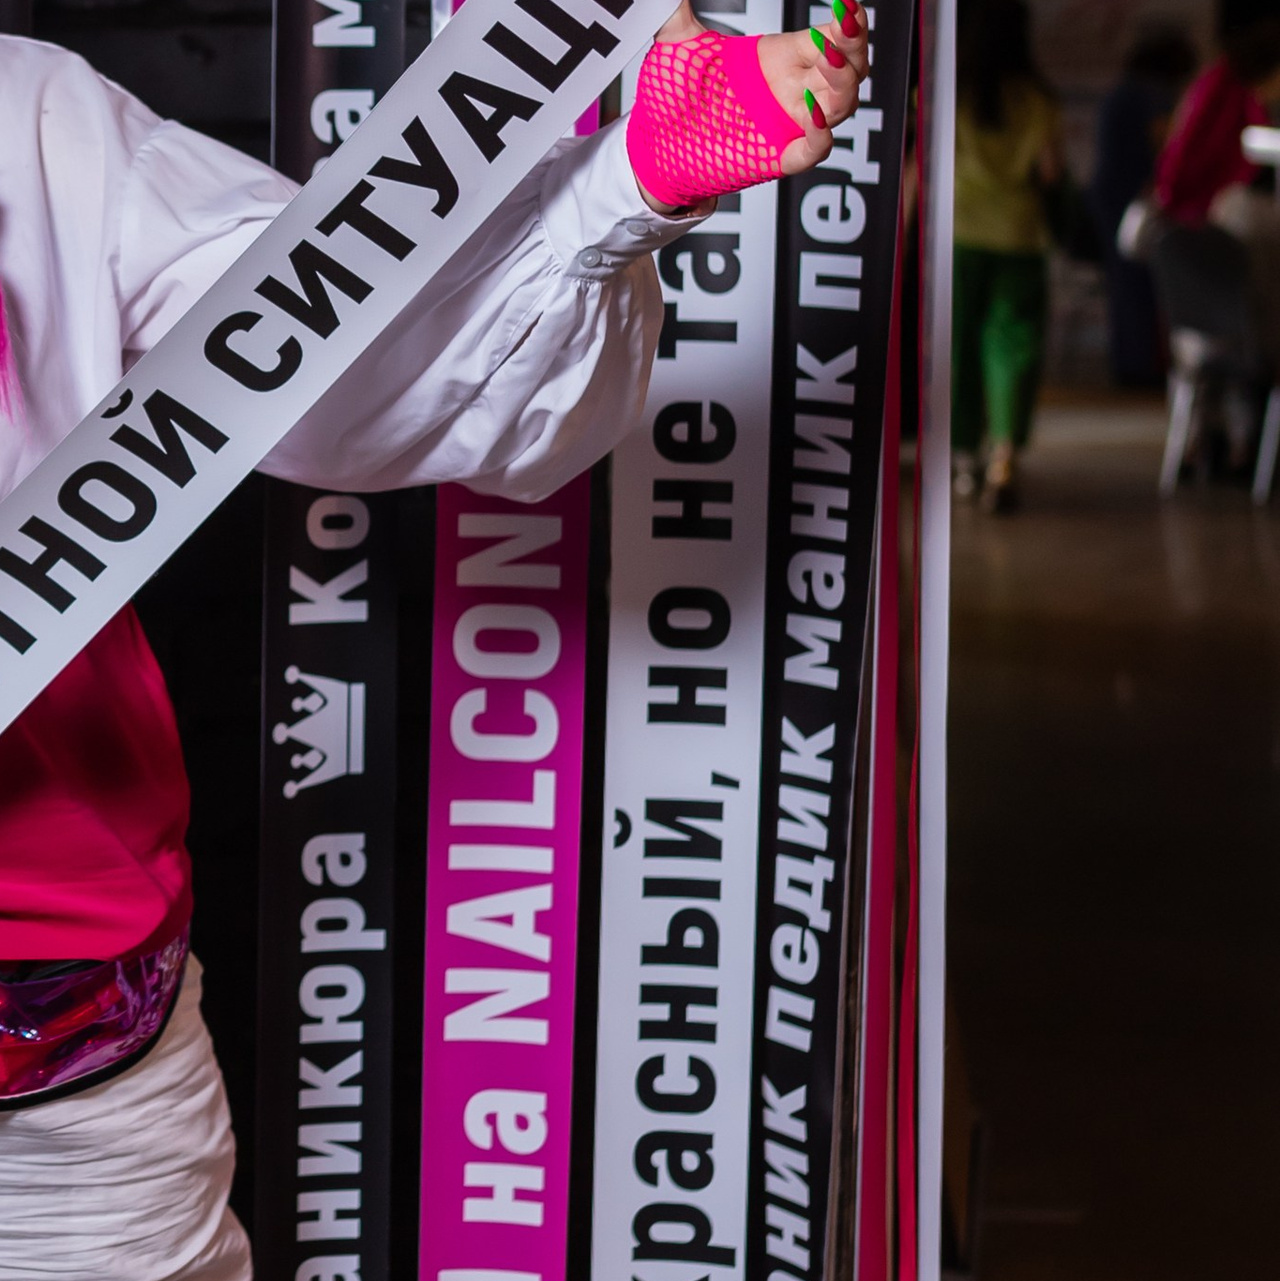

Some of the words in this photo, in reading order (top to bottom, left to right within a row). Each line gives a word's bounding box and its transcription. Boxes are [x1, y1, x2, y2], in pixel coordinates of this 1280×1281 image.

[651, 400, 738, 542] не
[783, 343, 859, 691] маник
[646, 586, 732, 727] но
[442, 511, 563, 1046] NAILCON
[763, 716, 837, 1053] педик
[461, 1087, 549, 1228] на
